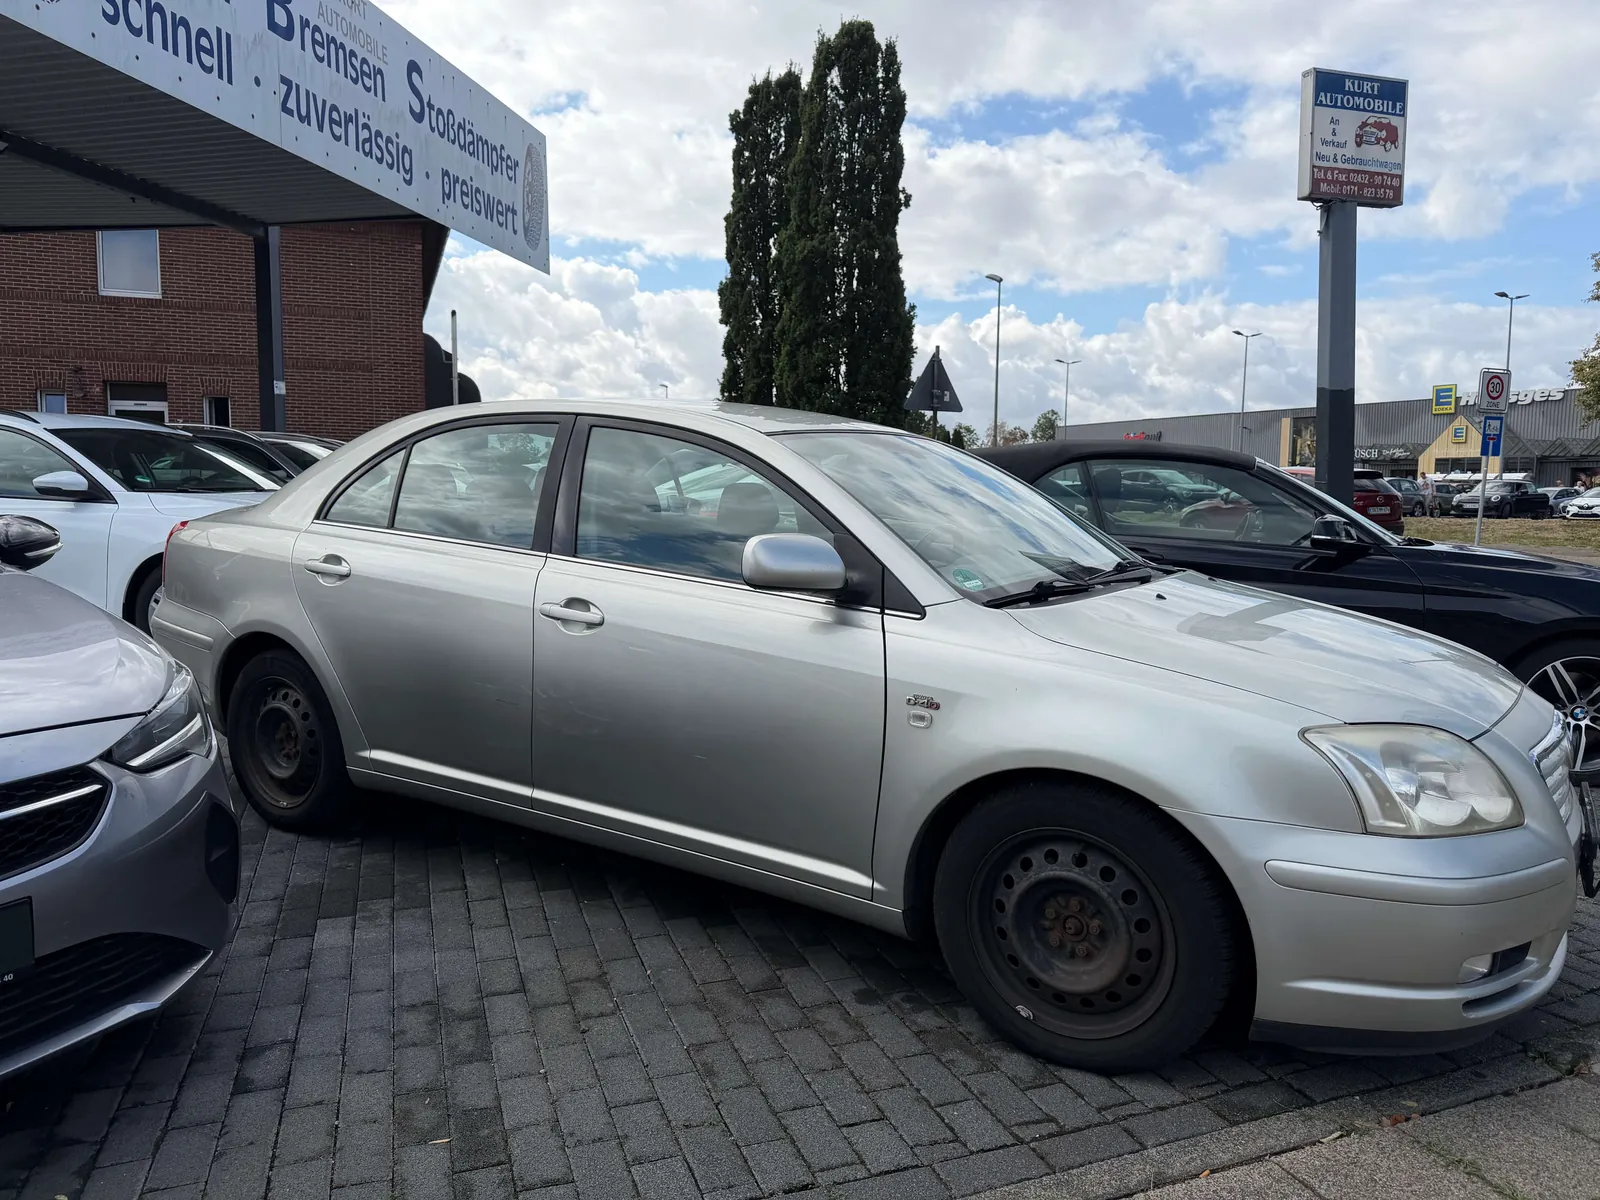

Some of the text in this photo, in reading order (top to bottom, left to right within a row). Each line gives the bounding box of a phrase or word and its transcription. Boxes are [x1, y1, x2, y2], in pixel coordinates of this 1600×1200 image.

[317, 0, 388, 65] AUTOMOBILE
[267, 0, 519, 184] Bremsen Stoßdämpfer
[1345, 79, 1380, 94] KURT
[1316, 92, 1404, 114] AUTOMOBILE
[1329, 116, 1340, 126] An
[1331, 127, 1337, 137] &
[1320, 137, 1348, 149] Verkauf
[280, 74, 413, 186] zuverlässig
[441, 167, 517, 235] preiswert
[1315, 151, 1402, 171] Neu & Gebrauchtwagen
[1313, 168, 1325, 179] Tel.
[1326, 170, 1333, 180] &
[1349, 172, 1369, 184] 02432
[1373, 175, 1382, 185] 90
[1391, 177, 1400, 187] 40
[1320, 182, 1341, 194] Mobil:
[1342, 185, 1358, 196] 0171
[1363, 187, 1375, 197] 823
[1489, 381, 1501, 394] 30
[1486, 400, 1501, 409] ZONE
